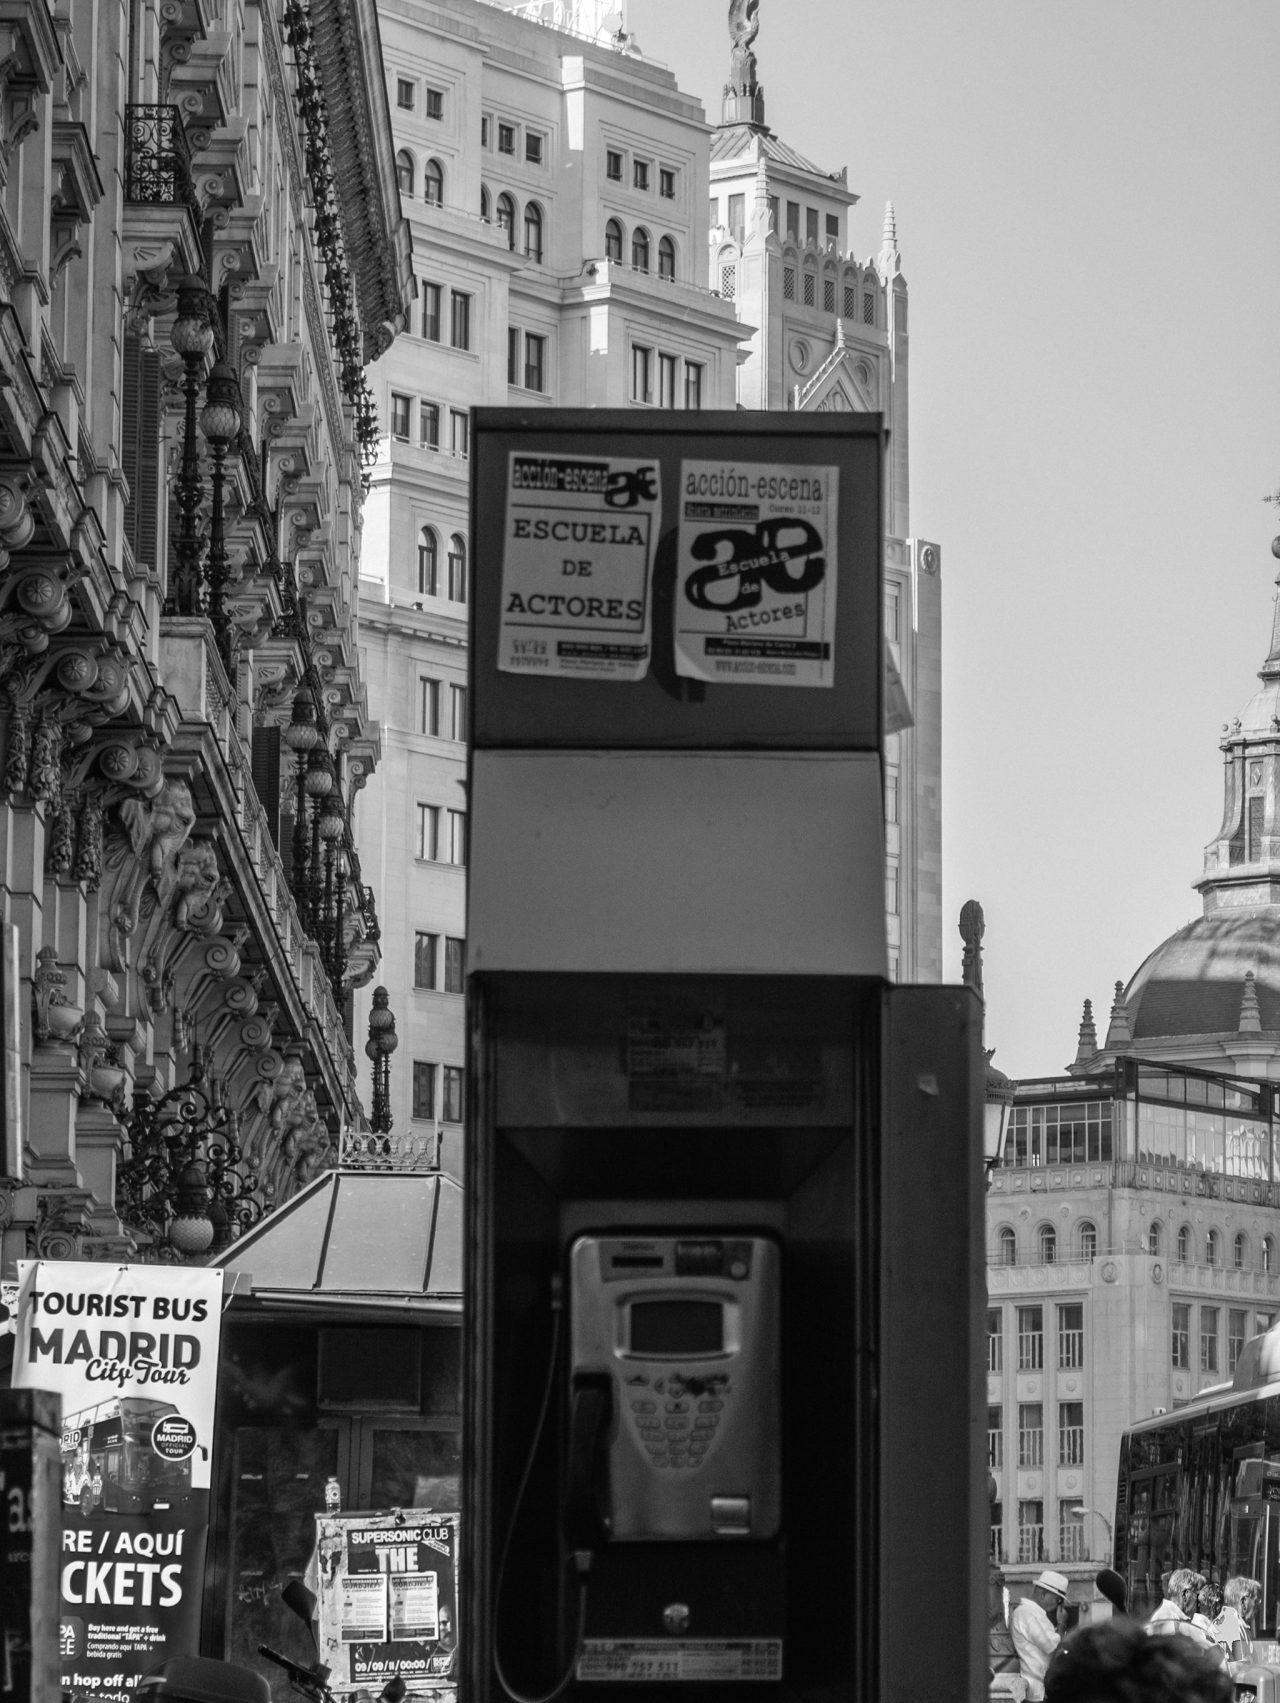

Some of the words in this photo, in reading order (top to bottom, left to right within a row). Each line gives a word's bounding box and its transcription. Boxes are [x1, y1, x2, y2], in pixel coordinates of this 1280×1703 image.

[686, 468, 823, 501] acción-escena
[513, 519, 646, 546] ESCUELA
[563, 558, 593, 578] DE
[717, 551, 791, 577] Escuela
[741, 582, 761, 594] de
[506, 593, 643, 621] ACTORES
[726, 603, 806, 632] Actores
[29, 1291, 147, 1319] TOURIST
[152, 1297, 208, 1323] BUS
[28, 1327, 202, 1371] MADRID
[85, 1358, 133, 1388] City
[133, 1359, 191, 1386] Tour
[156, 1434, 194, 1444] MADRID
[114, 1528, 186, 1559] AQUÍ
[351, 1531, 421, 1544] SUPERSONIC
[422, 1528, 449, 1541] CLUB
[375, 1547, 419, 1573] THE
[88, 1624, 101, 1634] Buy
[102, 1625, 115, 1633] here
[116, 1625, 128, 1633] and
[129, 1626, 141, 1635] get
[146, 1626, 159, 1634] free
[88, 1632, 122, 1641] traditional
[149, 1634, 167, 1643] drink
[87, 1642, 119, 1653] Comprando
[120, 1644, 132, 1653] aquí
[133, 1644, 148, 1652] TAPA
[87, 1650, 106, 1659] bebida
[106, 1652, 123, 1660] gratis
[74, 1672, 101, 1689] hop
[103, 1674, 125, 1688] off
